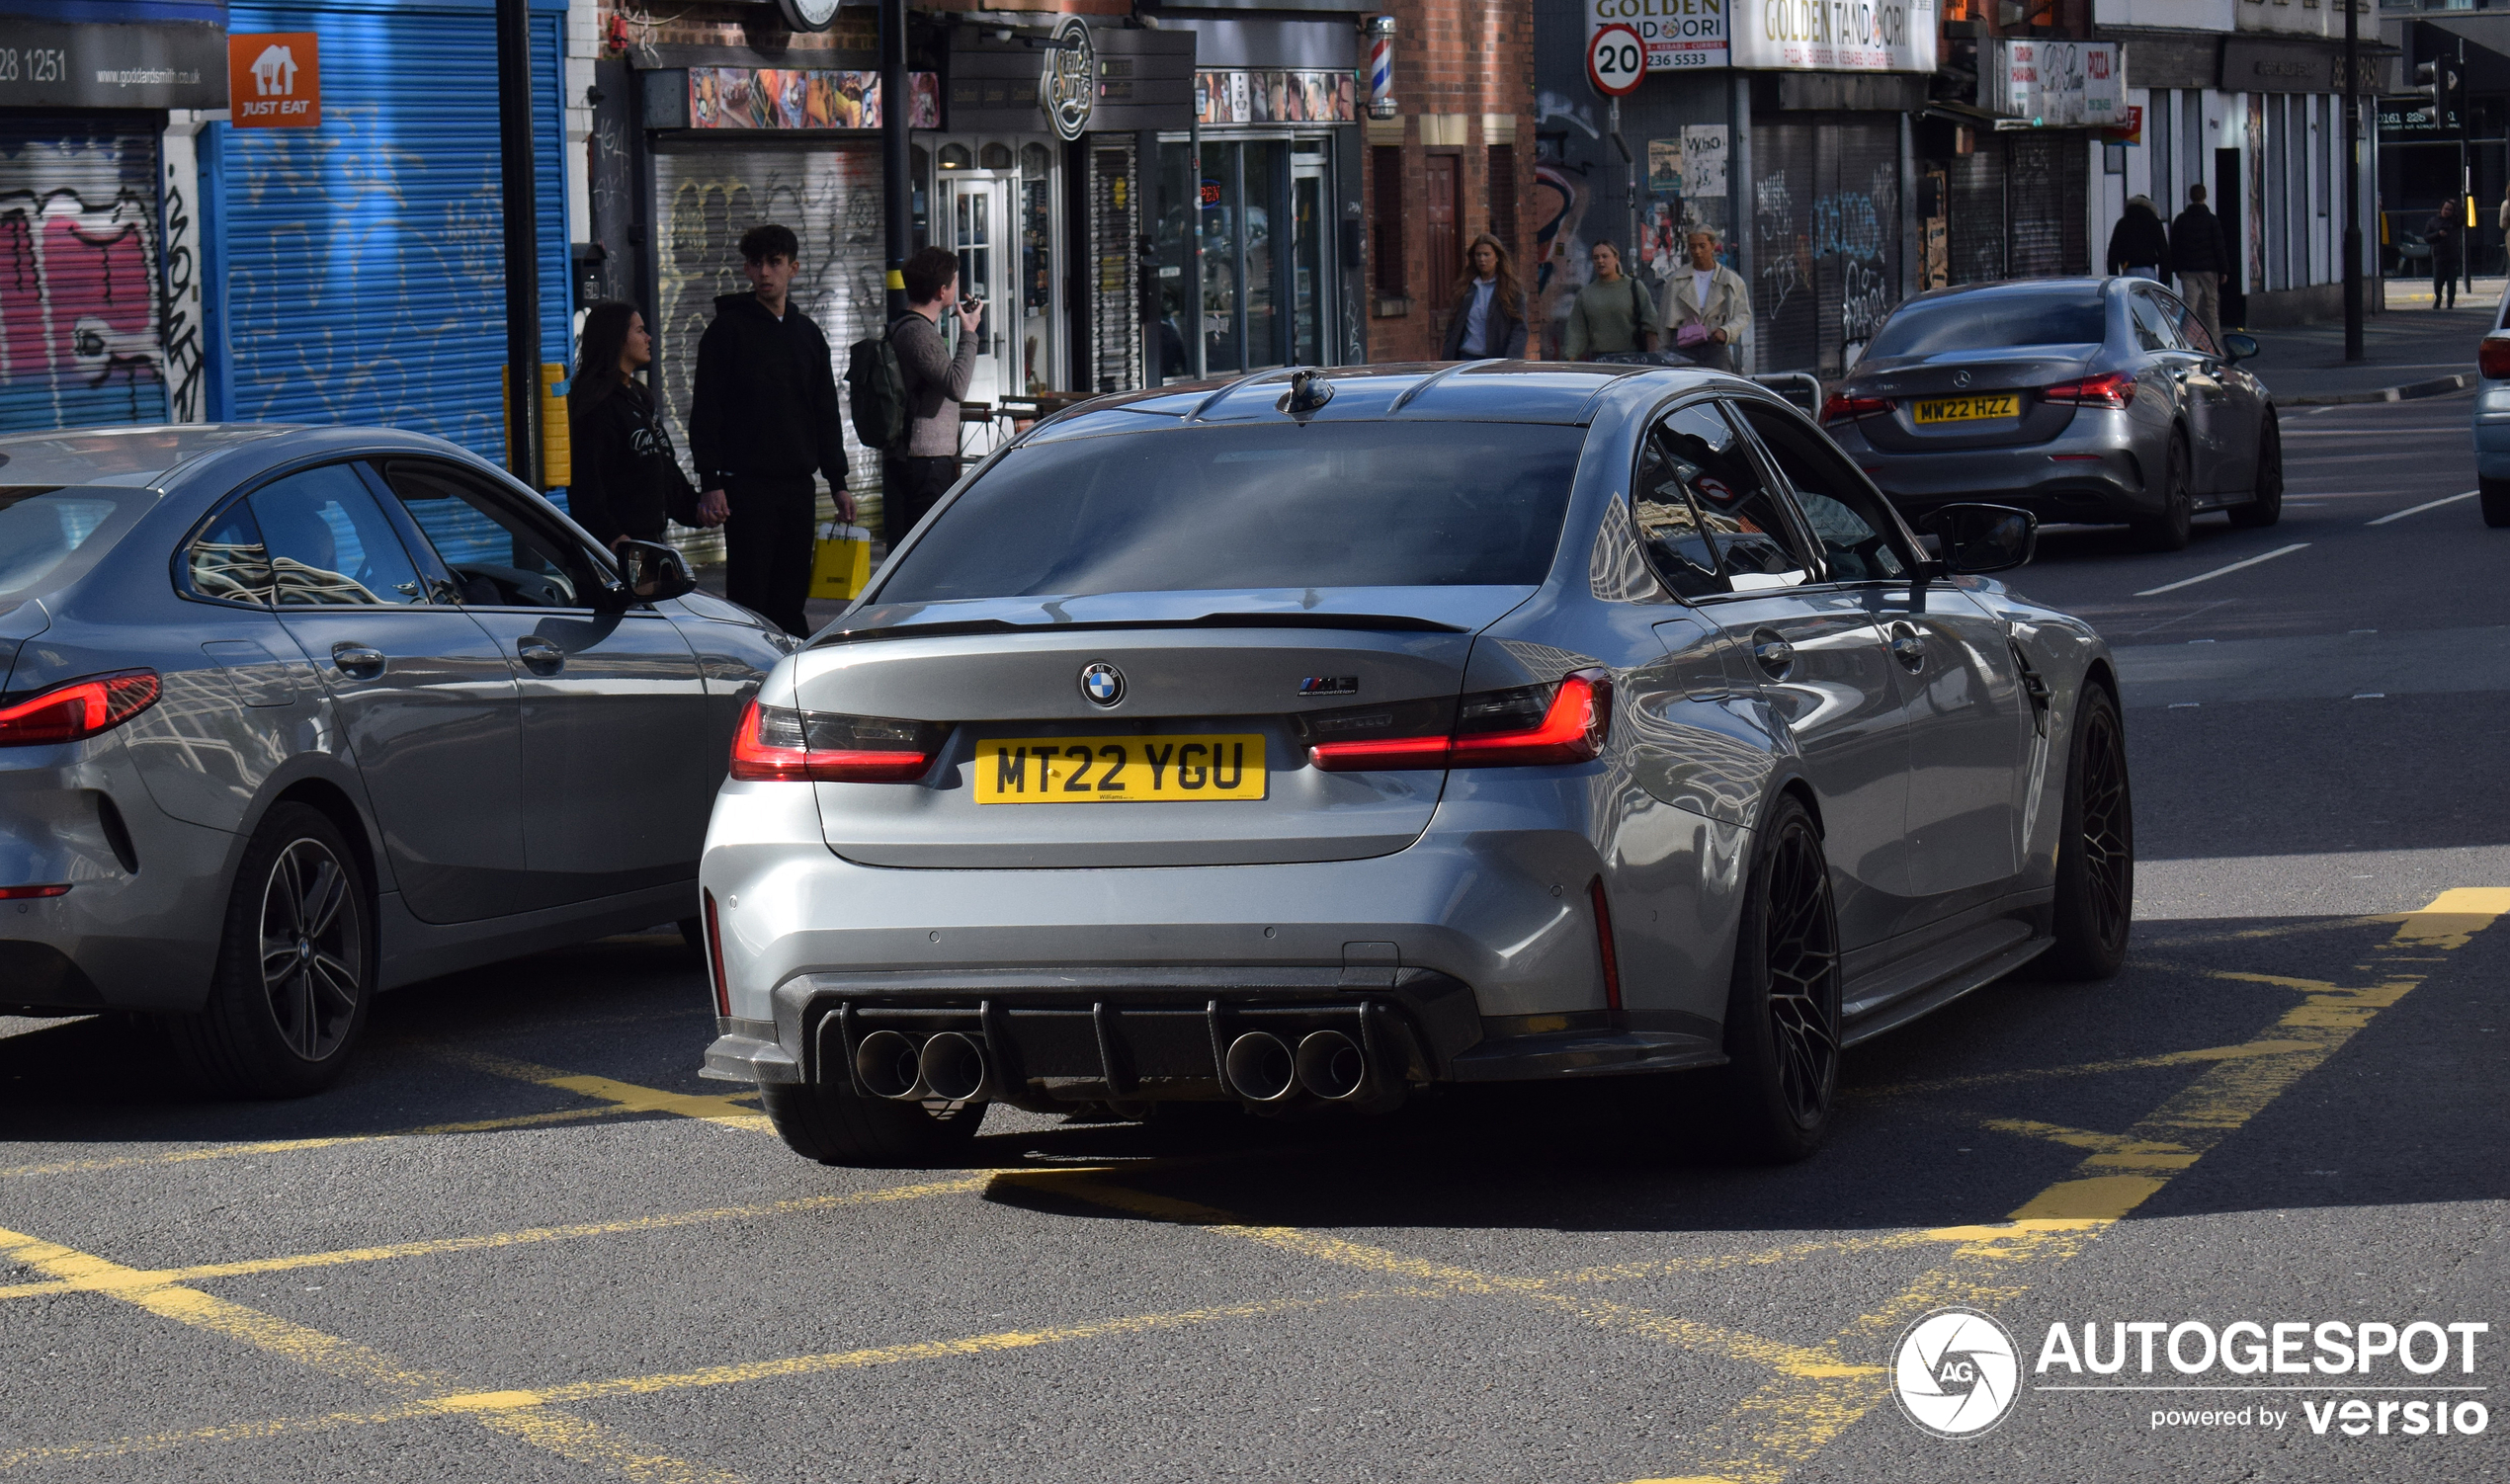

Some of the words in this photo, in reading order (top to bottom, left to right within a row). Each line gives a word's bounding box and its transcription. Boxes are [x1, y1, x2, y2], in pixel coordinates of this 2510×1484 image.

[1596, 0, 1720, 18] GOLDEN
[1764, 0, 1831, 43] GOLDEN
[1691, 41, 1723, 49] CURRIES
[24, 48, 66, 81] 1251
[1598, 44, 1639, 73] 20
[1647, 54, 1671, 66] 236
[1674, 53, 1707, 65] 5533
[1784, 48, 1802, 64] PIZZA
[1807, 48, 1833, 64] BURGER
[1838, 49, 1864, 66] KEBABS
[2087, 50, 2110, 80] PIZZA
[96, 67, 202, 88] www.goddardsmith.co.uk
[241, 101, 279, 118] JUST
[280, 100, 310, 115] EAT
[2378, 112, 2401, 124] 0161
[1201, 184, 1221, 204] PEN
[1921, 400, 1969, 421] MW22
[1974, 396, 2012, 416] HZZ
[1084, 665, 1119, 679] BMW
[1314, 676, 1359, 691] M3
[996, 745, 1127, 793] MT22
[1144, 742, 1243, 790] YGU
